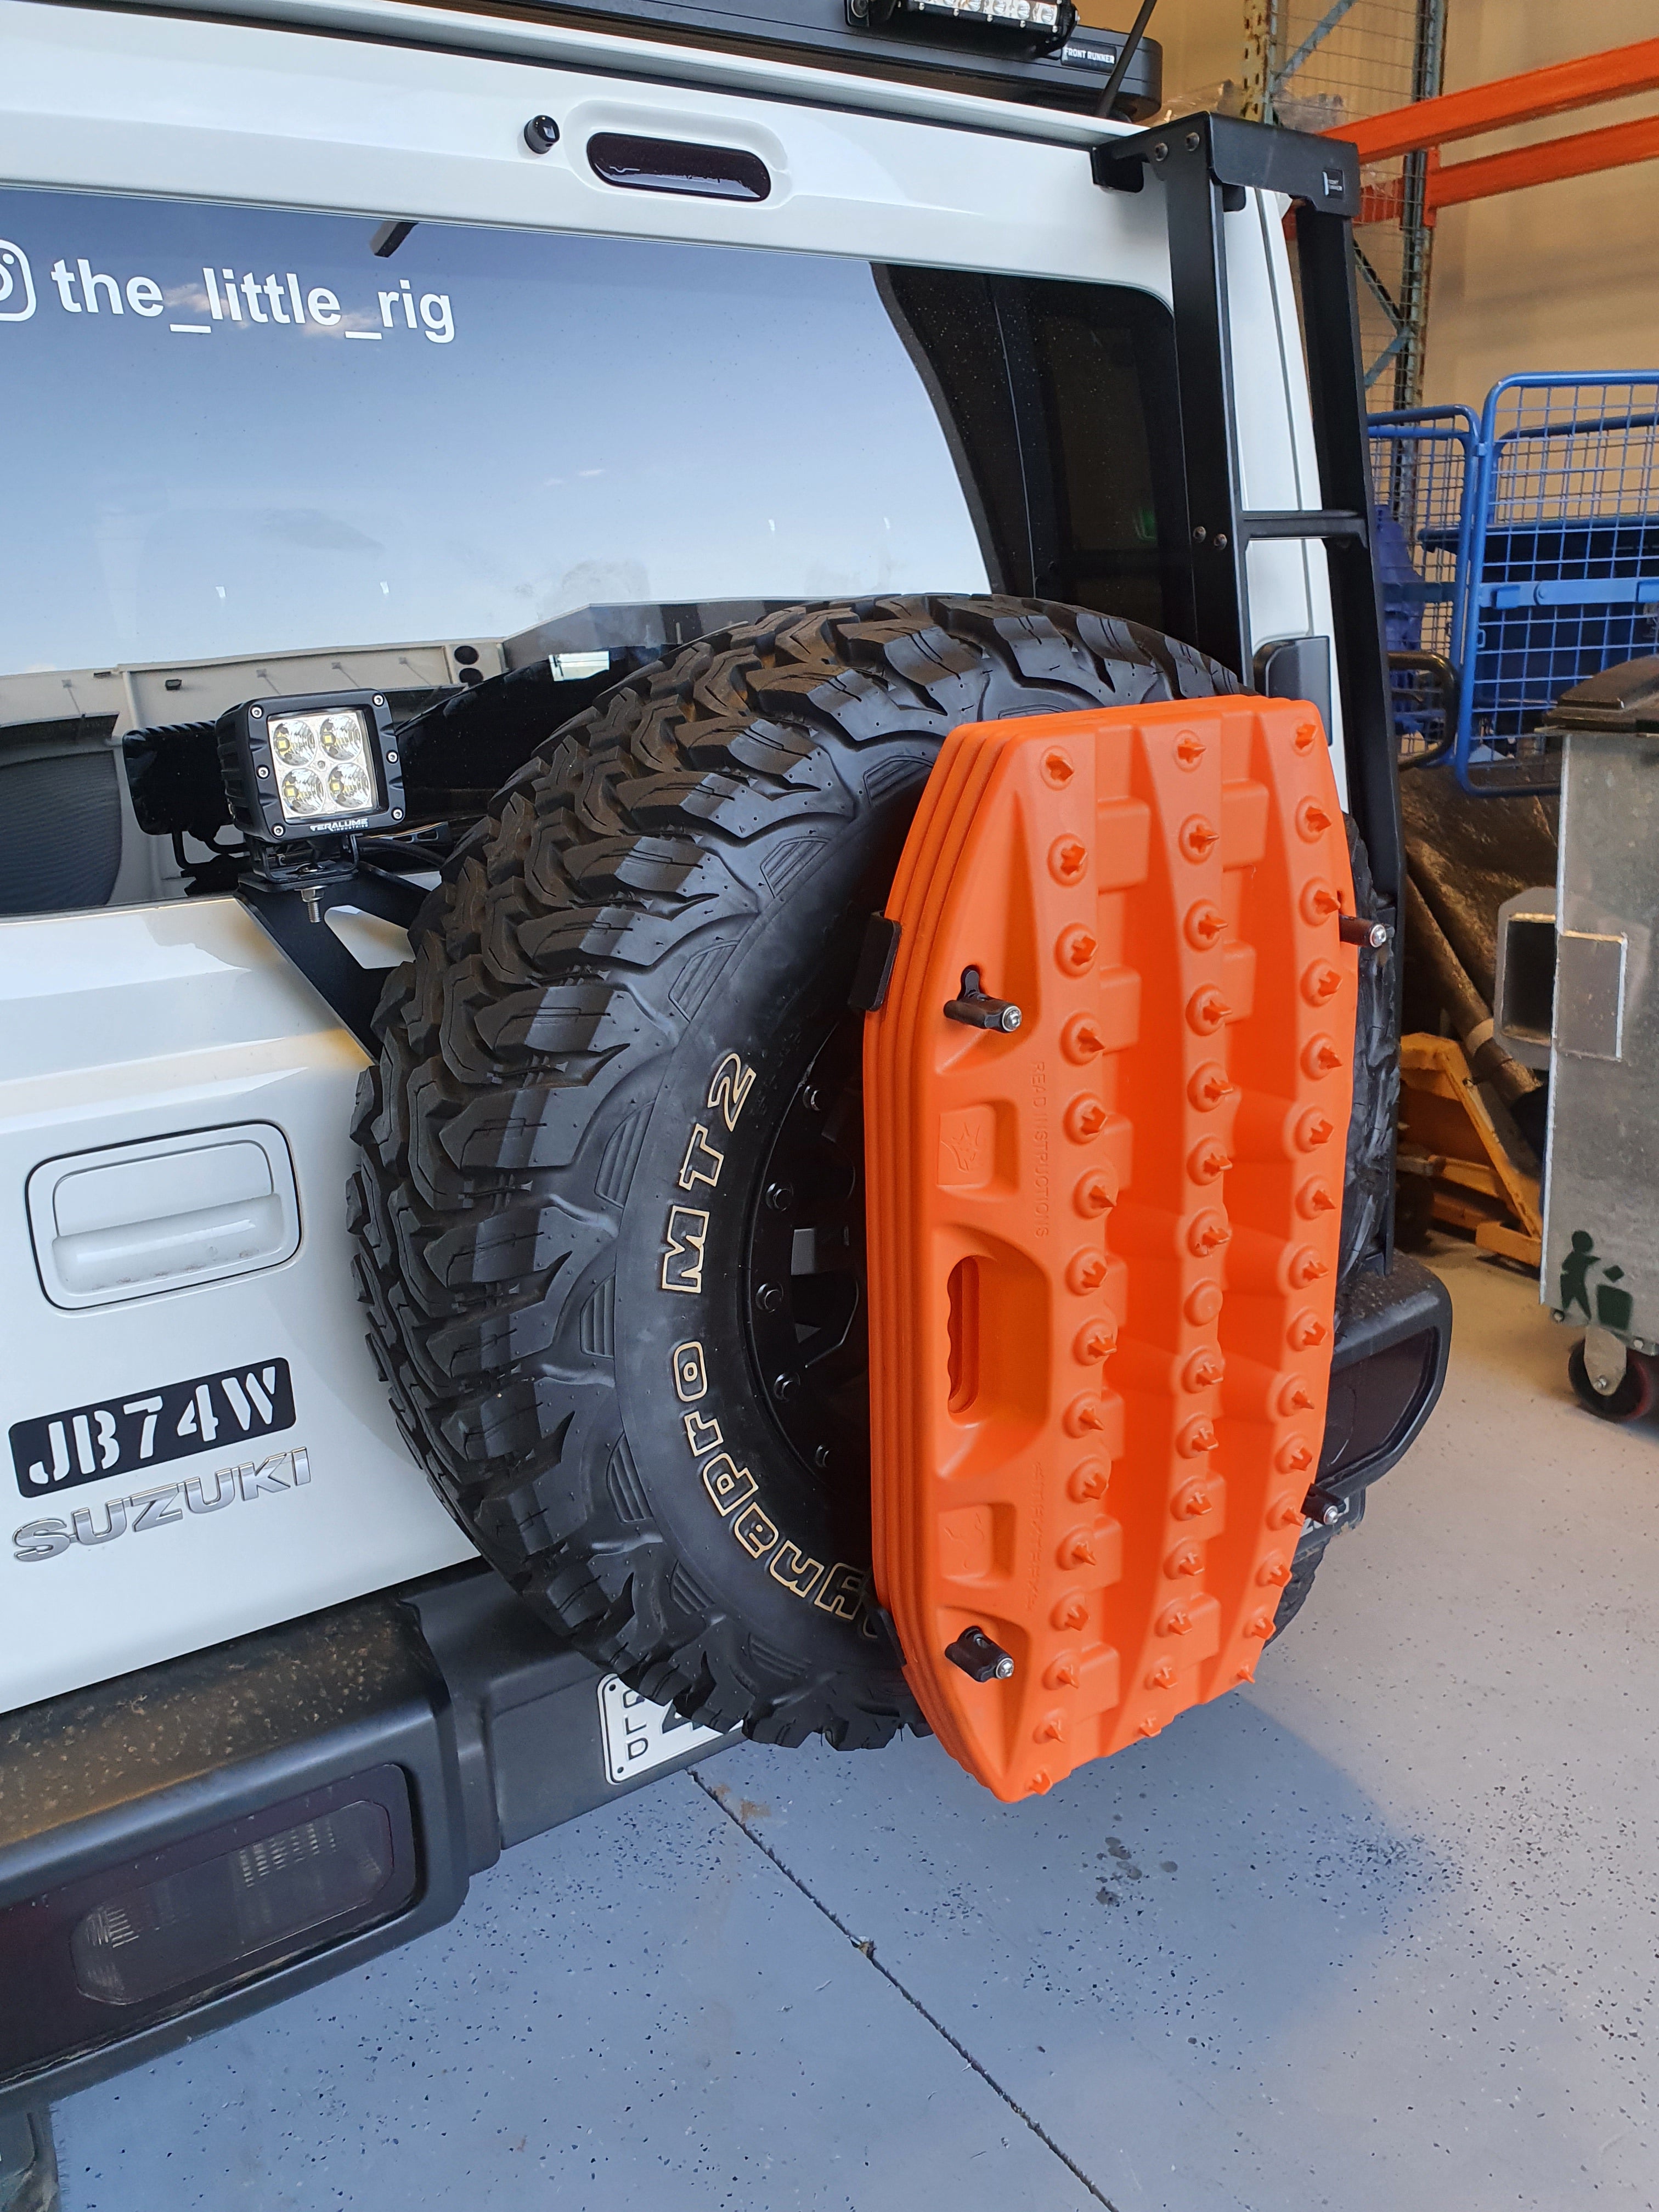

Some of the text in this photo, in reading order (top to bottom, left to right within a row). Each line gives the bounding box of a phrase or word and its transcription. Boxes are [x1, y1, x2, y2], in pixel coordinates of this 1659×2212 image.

[1063, 47, 1115, 64] FRONT RUNNER
[50, 258, 455, 344] the_little_rig
[309, 818, 368, 832] TERALUME
[29, 1365, 275, 1484] JB74W
[12, 1446, 312, 1562] SUZUKI
